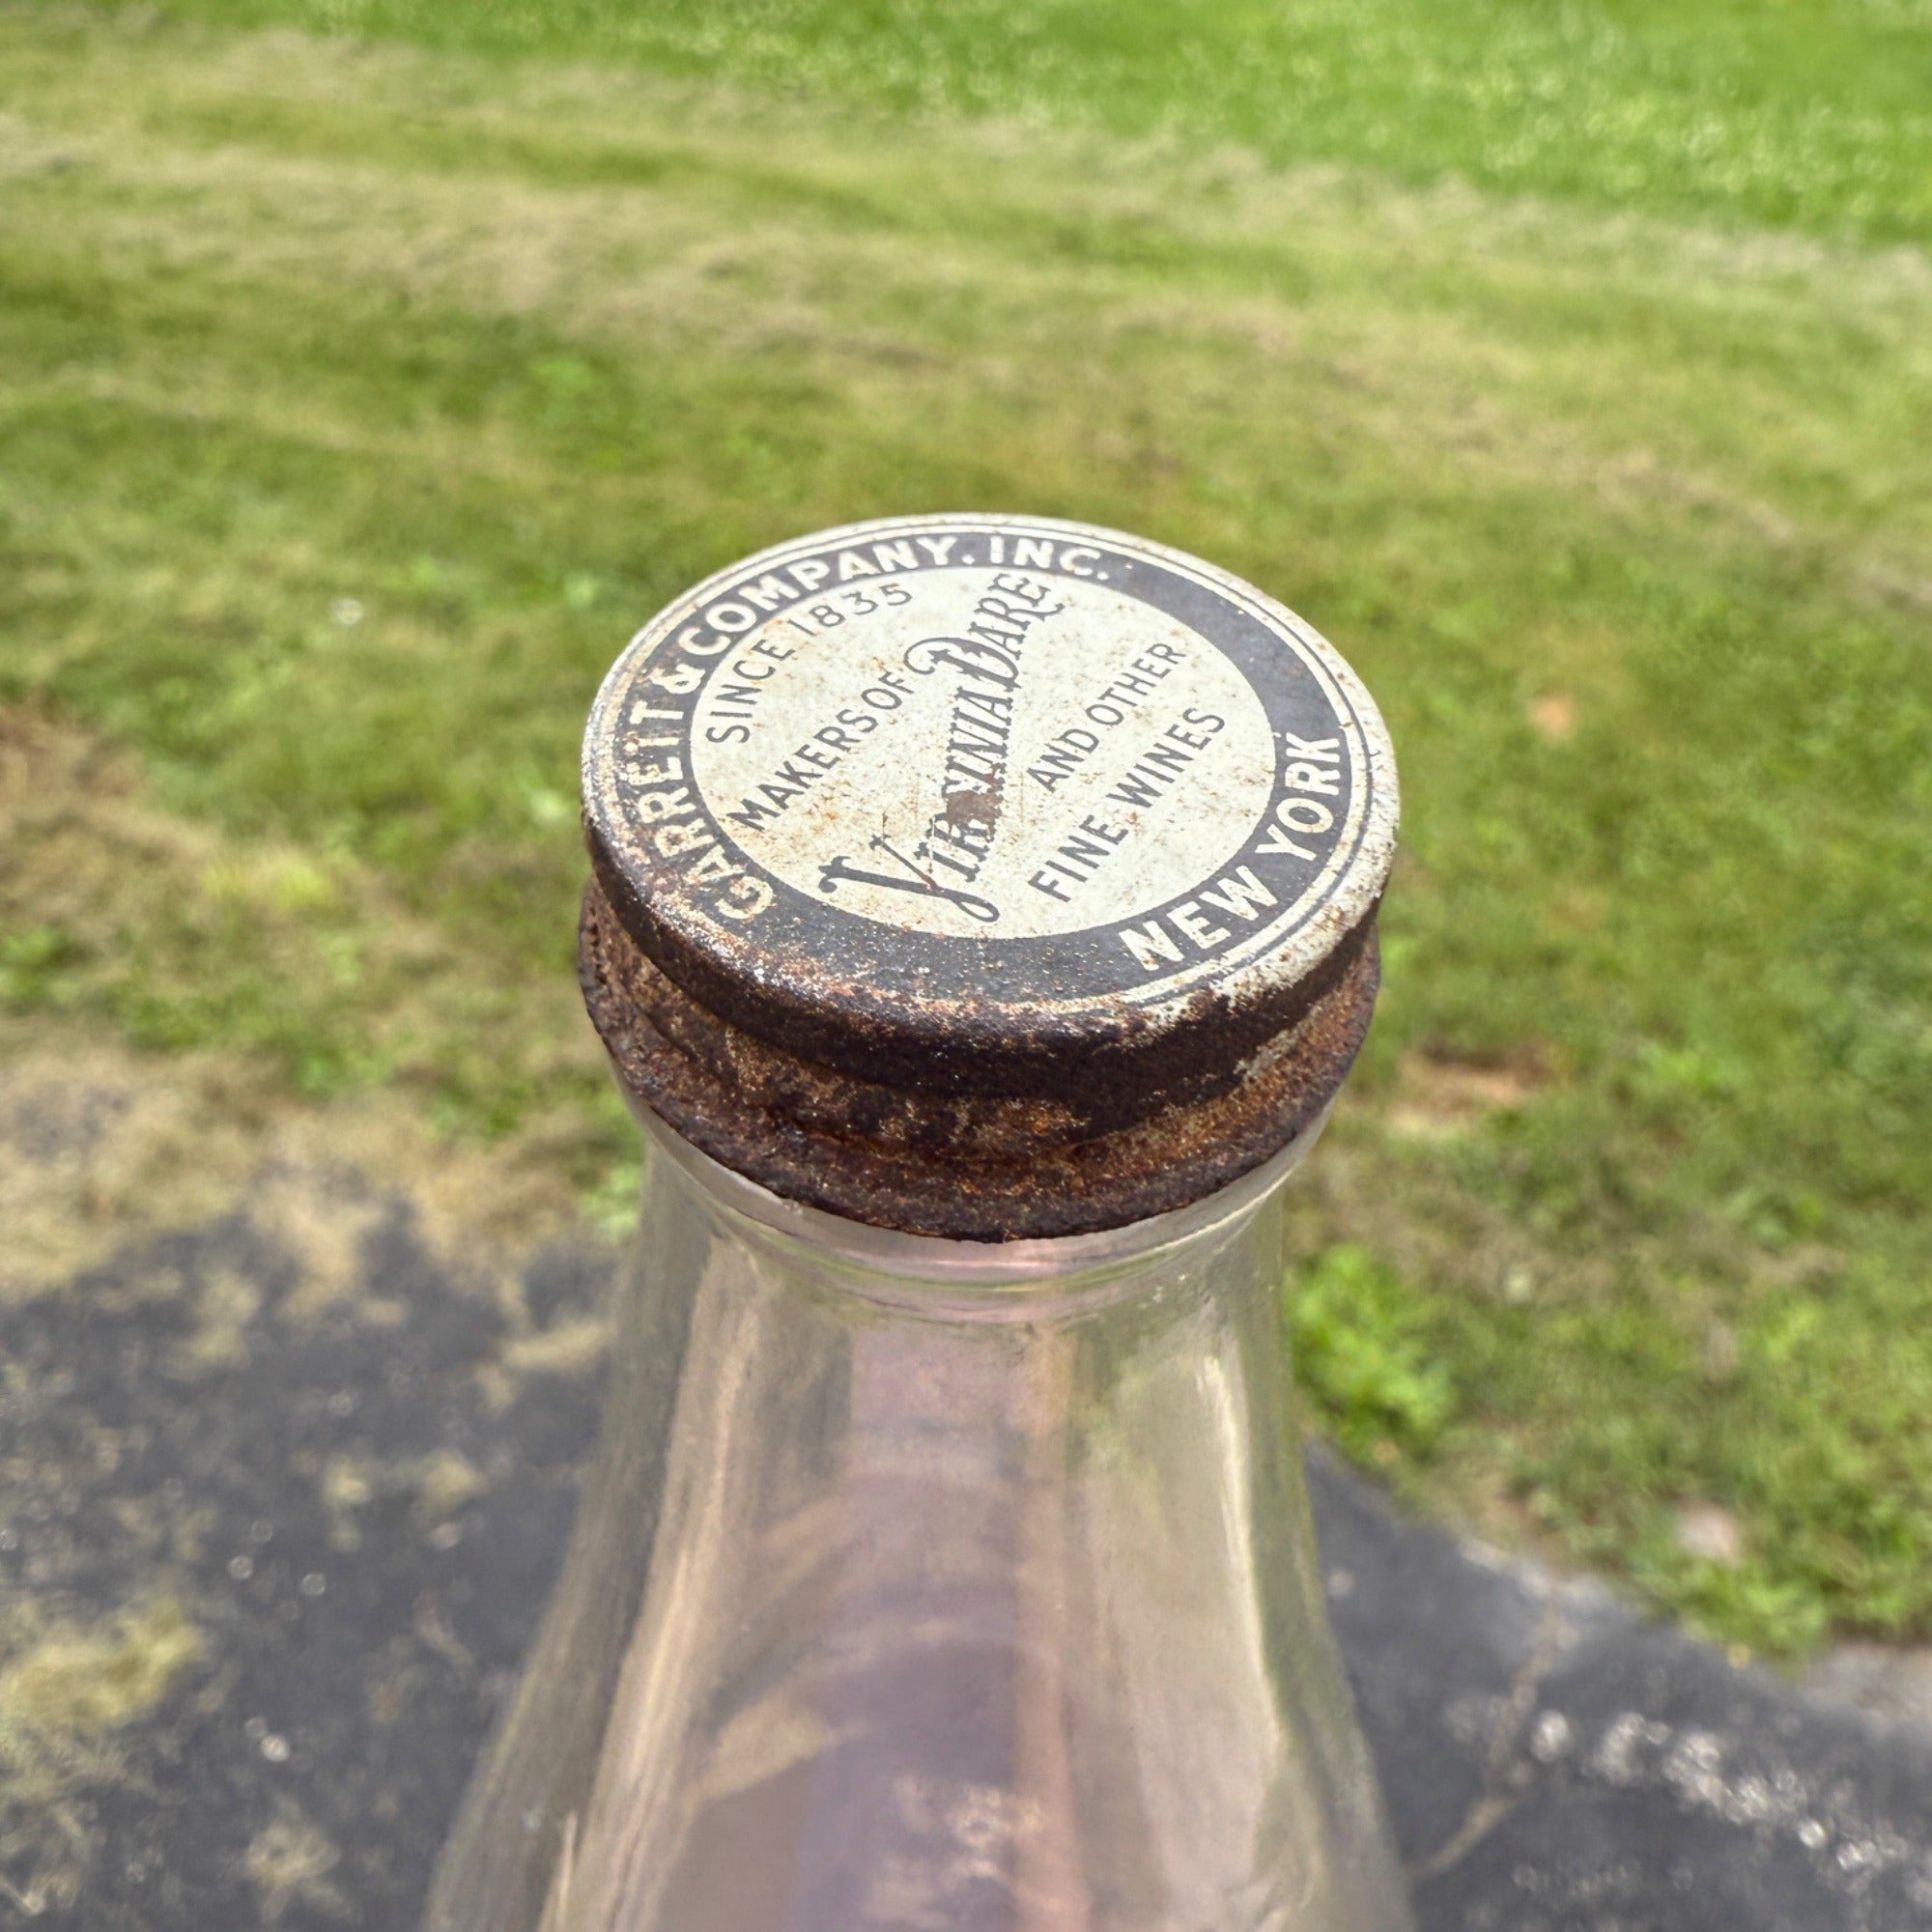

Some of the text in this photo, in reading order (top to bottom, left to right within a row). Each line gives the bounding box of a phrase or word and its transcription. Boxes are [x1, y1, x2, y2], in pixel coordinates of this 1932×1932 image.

[649, 664, 706, 695] &
[706, 582, 913, 744] SINCE 1835
[903, 573, 1065, 693] DARE
[726, 671, 915, 832] MAKERS OF
[1026, 641, 1188, 793] AND OTHER
[625, 700, 775, 919] GARRETT
[1027, 707, 1227, 902] FINE WINES
[1118, 731, 1343, 972] NEW YORK
